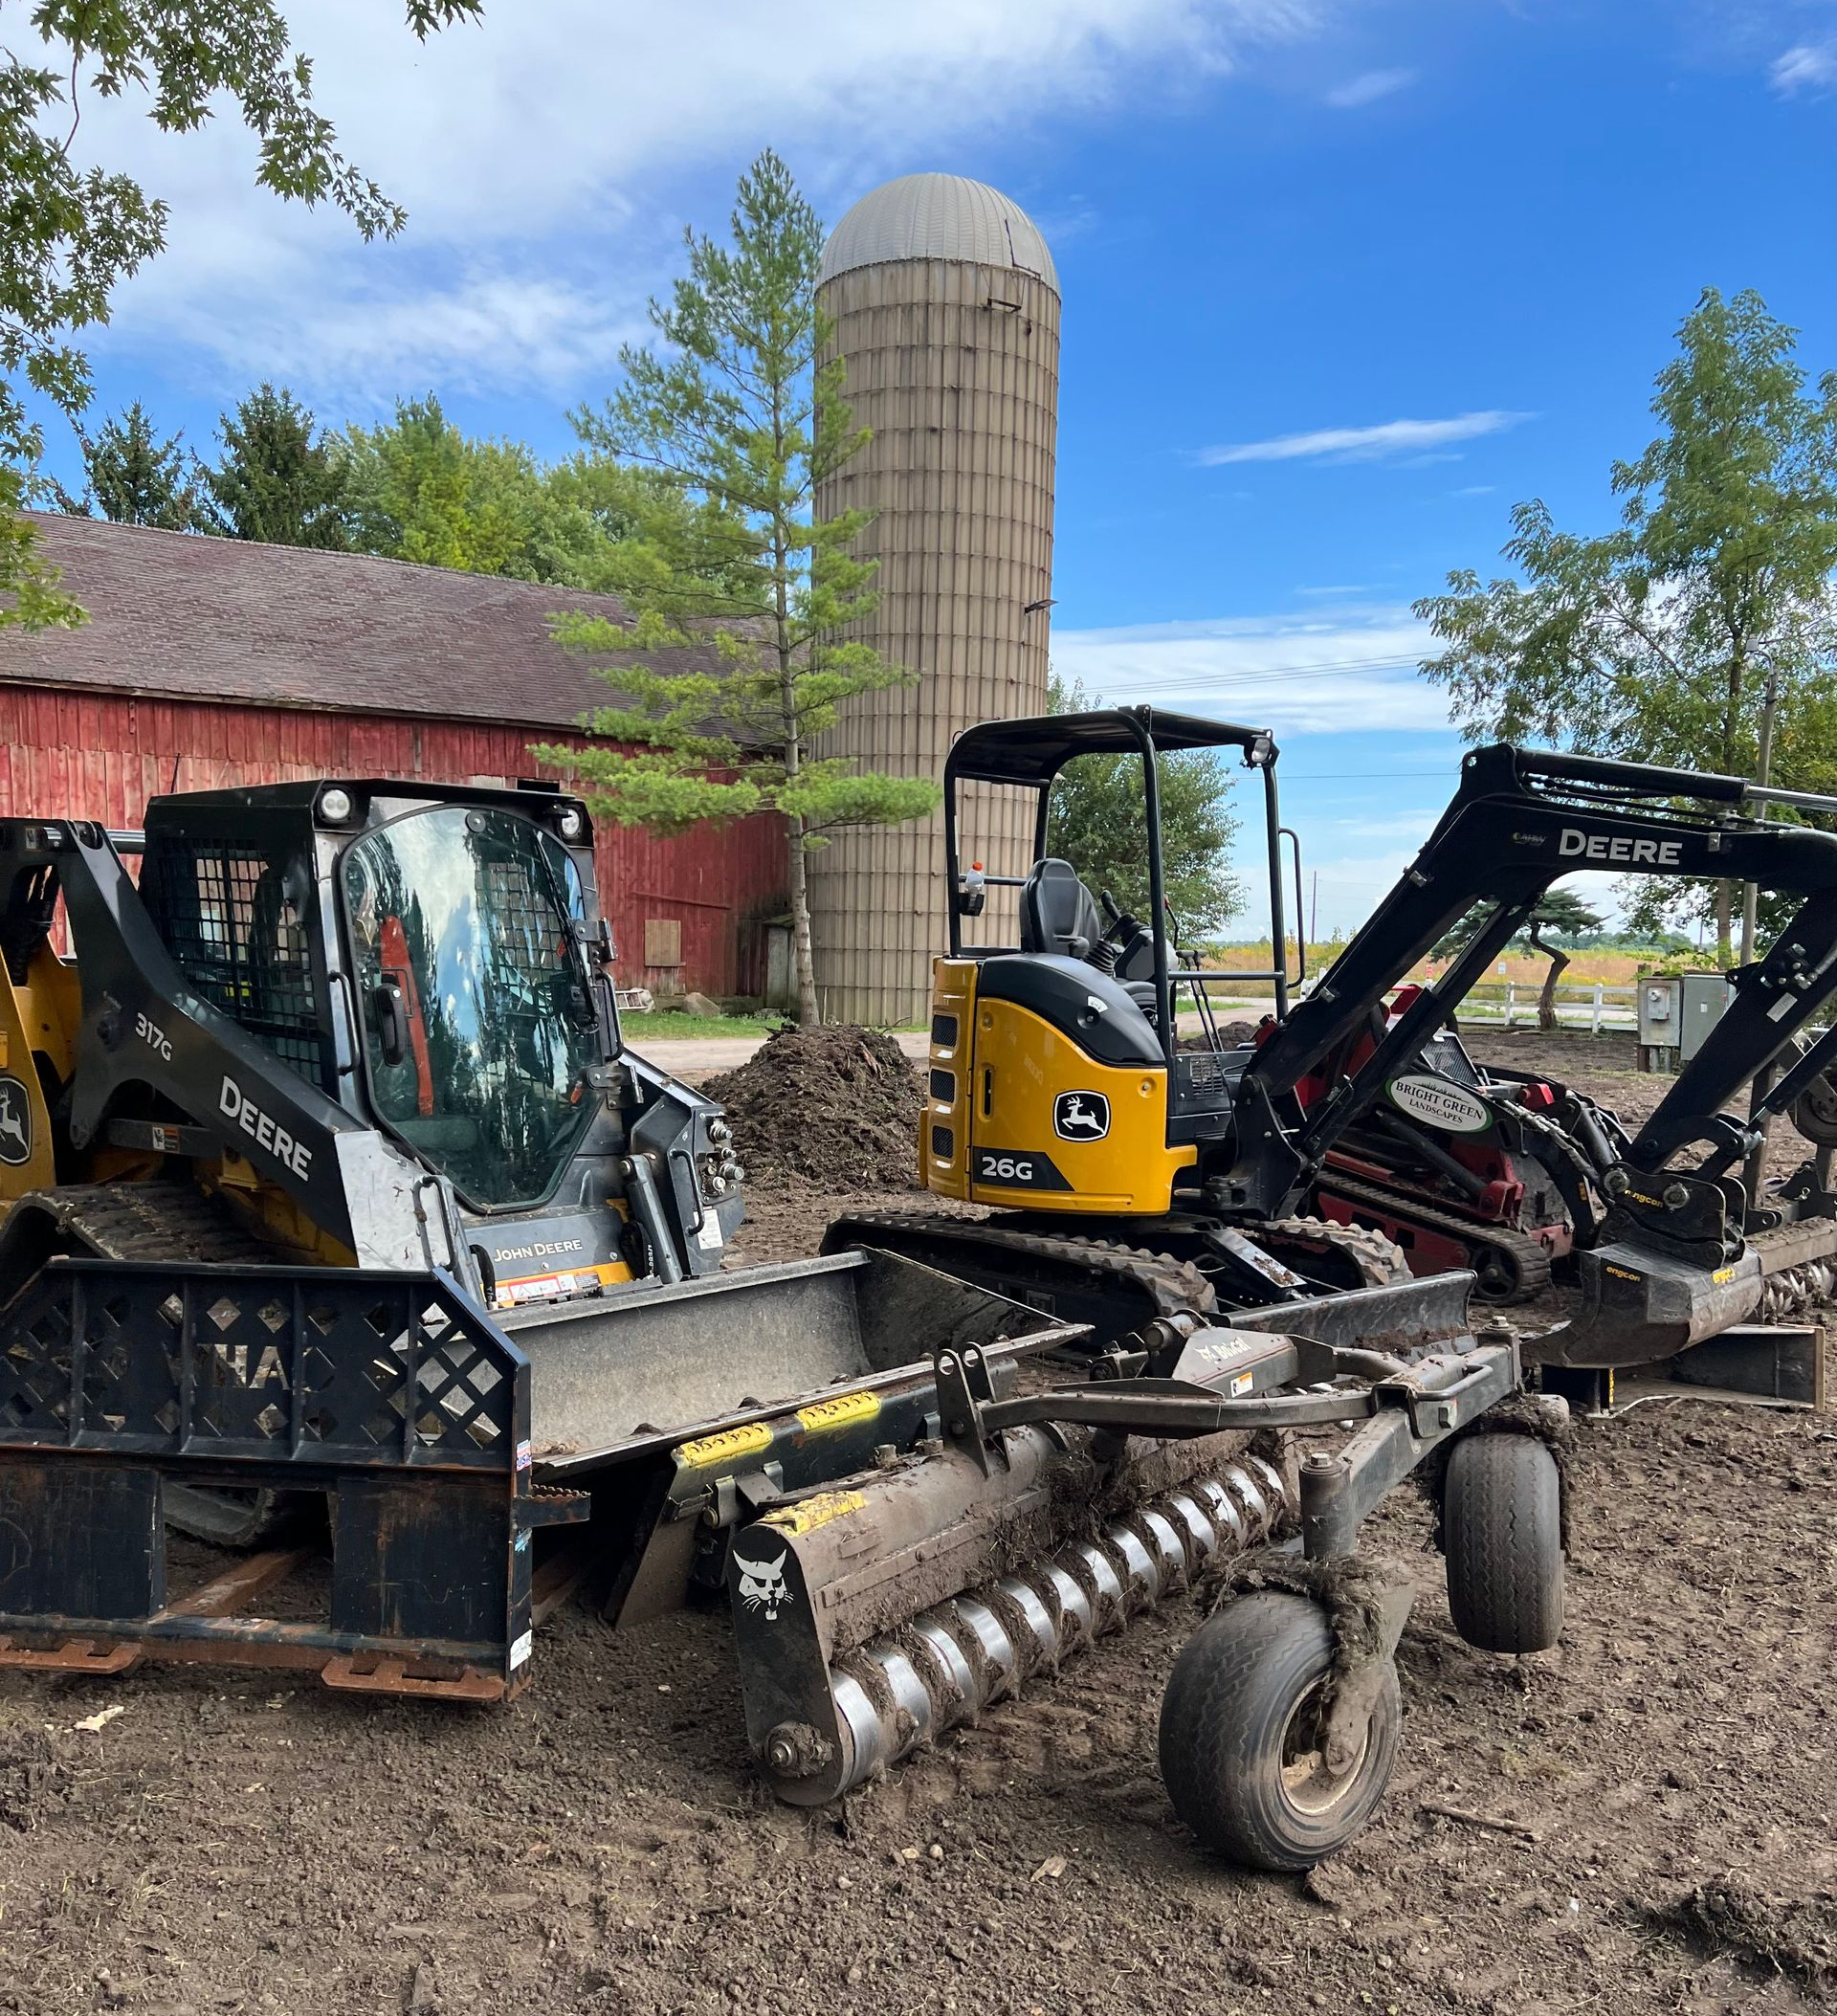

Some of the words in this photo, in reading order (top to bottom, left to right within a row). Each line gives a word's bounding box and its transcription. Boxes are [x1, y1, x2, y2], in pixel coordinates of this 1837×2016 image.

[1559, 829, 1683, 865] DEERE
[135, 1012, 172, 1061] 317G
[1396, 1082, 1441, 1104] BRIGHT
[1443, 1099, 1484, 1119] GREEN
[1409, 1098, 1463, 1123] LANDSCAPES
[219, 1075, 312, 1182] DEERE
[982, 1156, 1032, 1180] 26G
[494, 1246, 533, 1262] JOHN
[534, 1239, 583, 1255] DEERE
[1606, 1265, 1641, 1282] engcon
